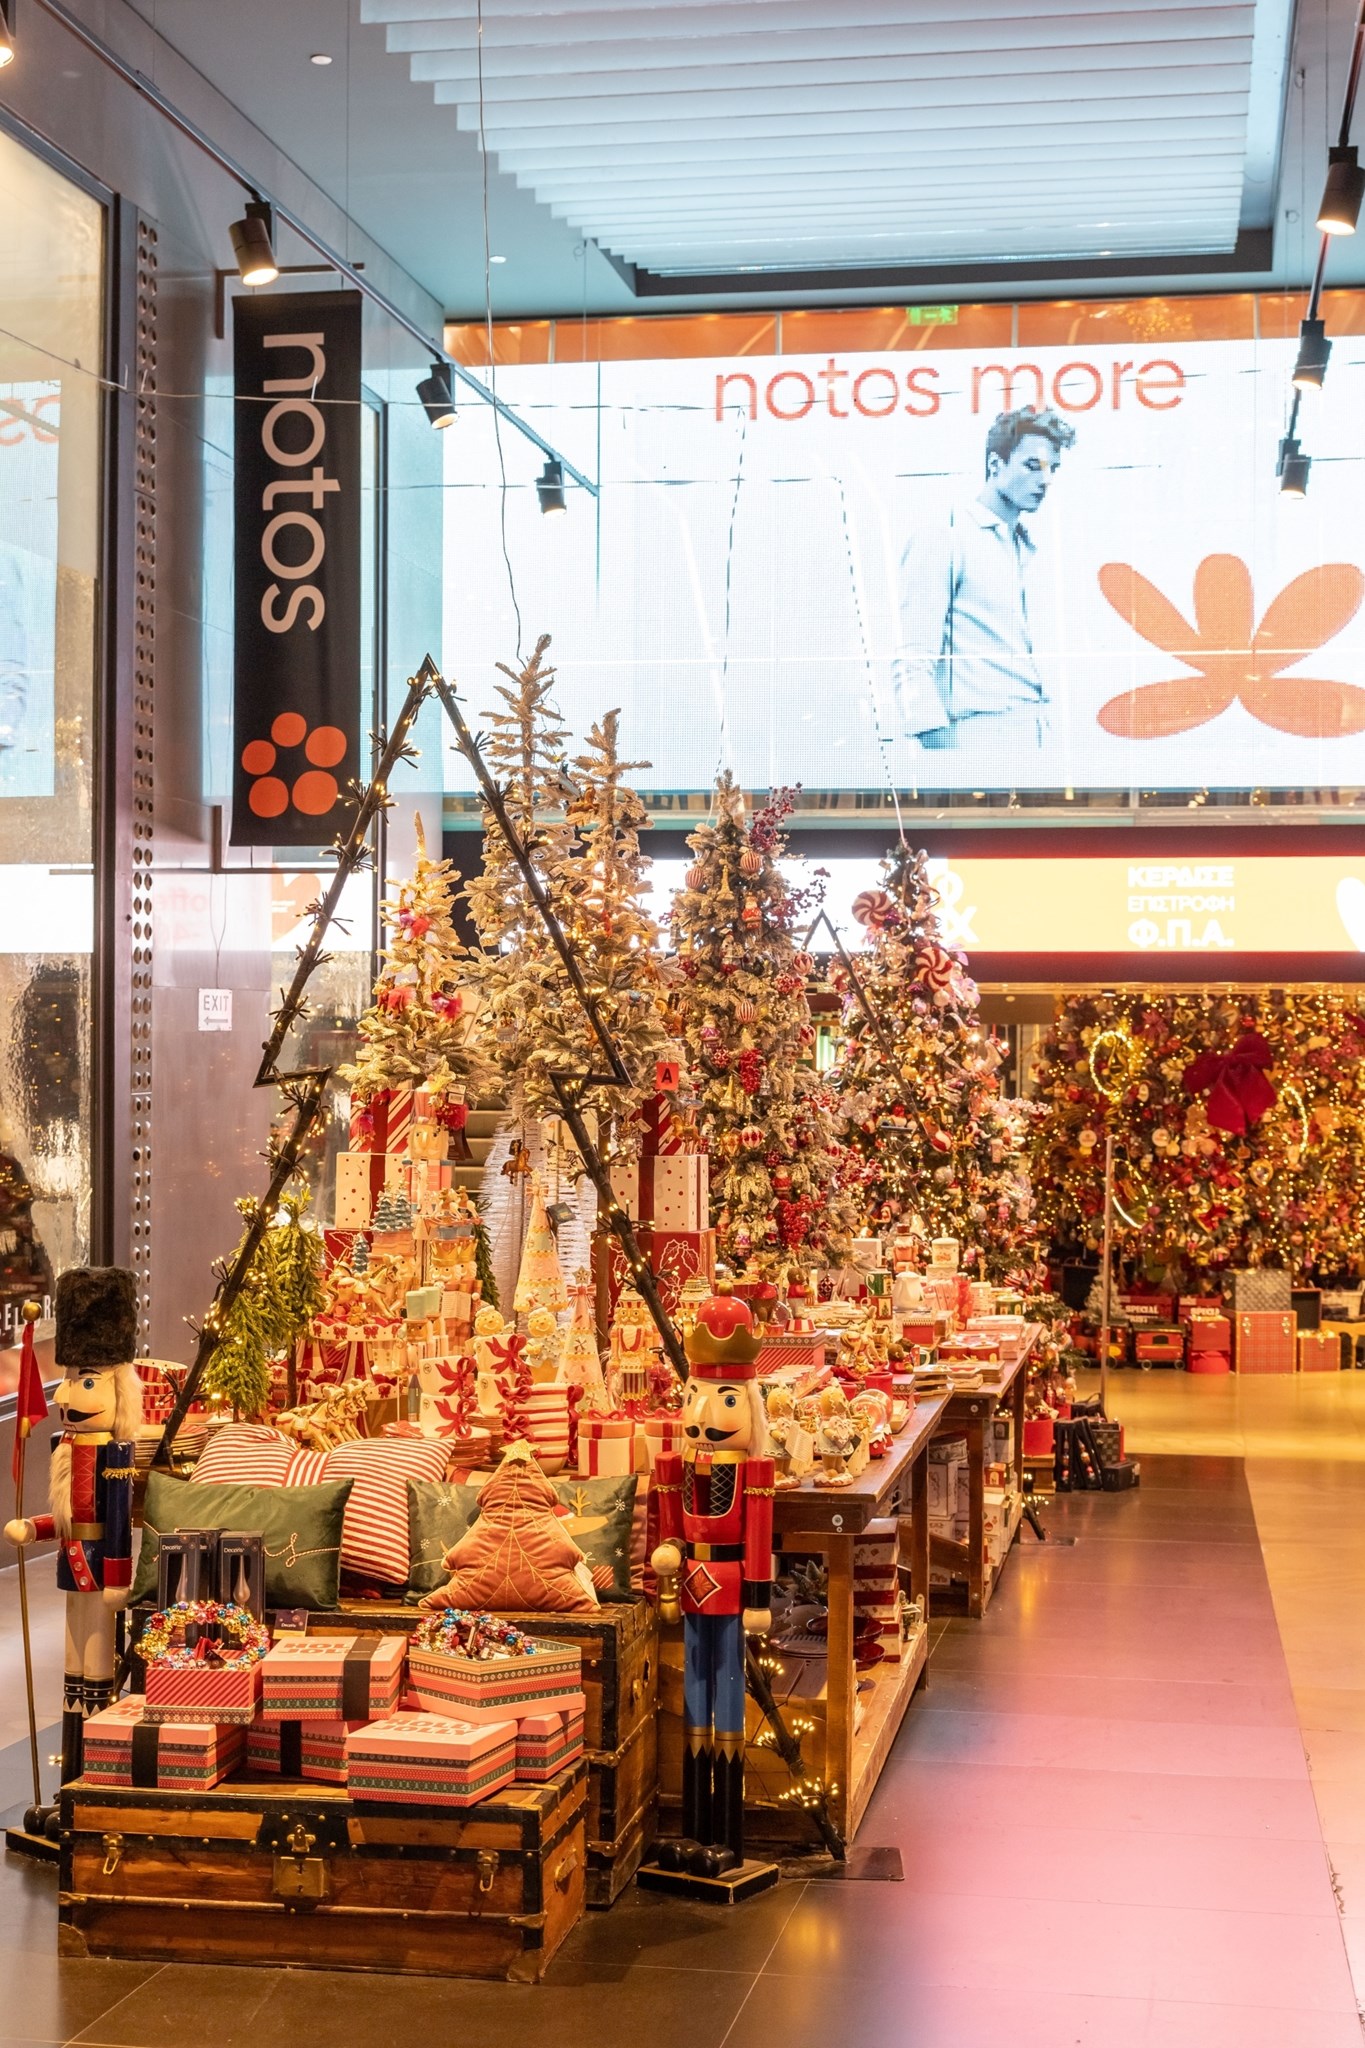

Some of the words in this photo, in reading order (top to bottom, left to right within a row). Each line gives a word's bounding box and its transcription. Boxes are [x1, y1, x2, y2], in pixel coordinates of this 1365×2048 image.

[715, 358, 941, 422] notos
[971, 359, 1186, 415] more
[261, 332, 341, 634] notos
[1127, 865, 1235, 888] ΚΕΡΔΙΣΕ
[1127, 918, 1235, 948] Φ.Π.Α.
[203, 994, 230, 1012] EXIT
[661, 1067, 673, 1084] A
[1126, 1305, 1159, 1314] SPECIAL
[371, 1725, 477, 1736] JOLLY
